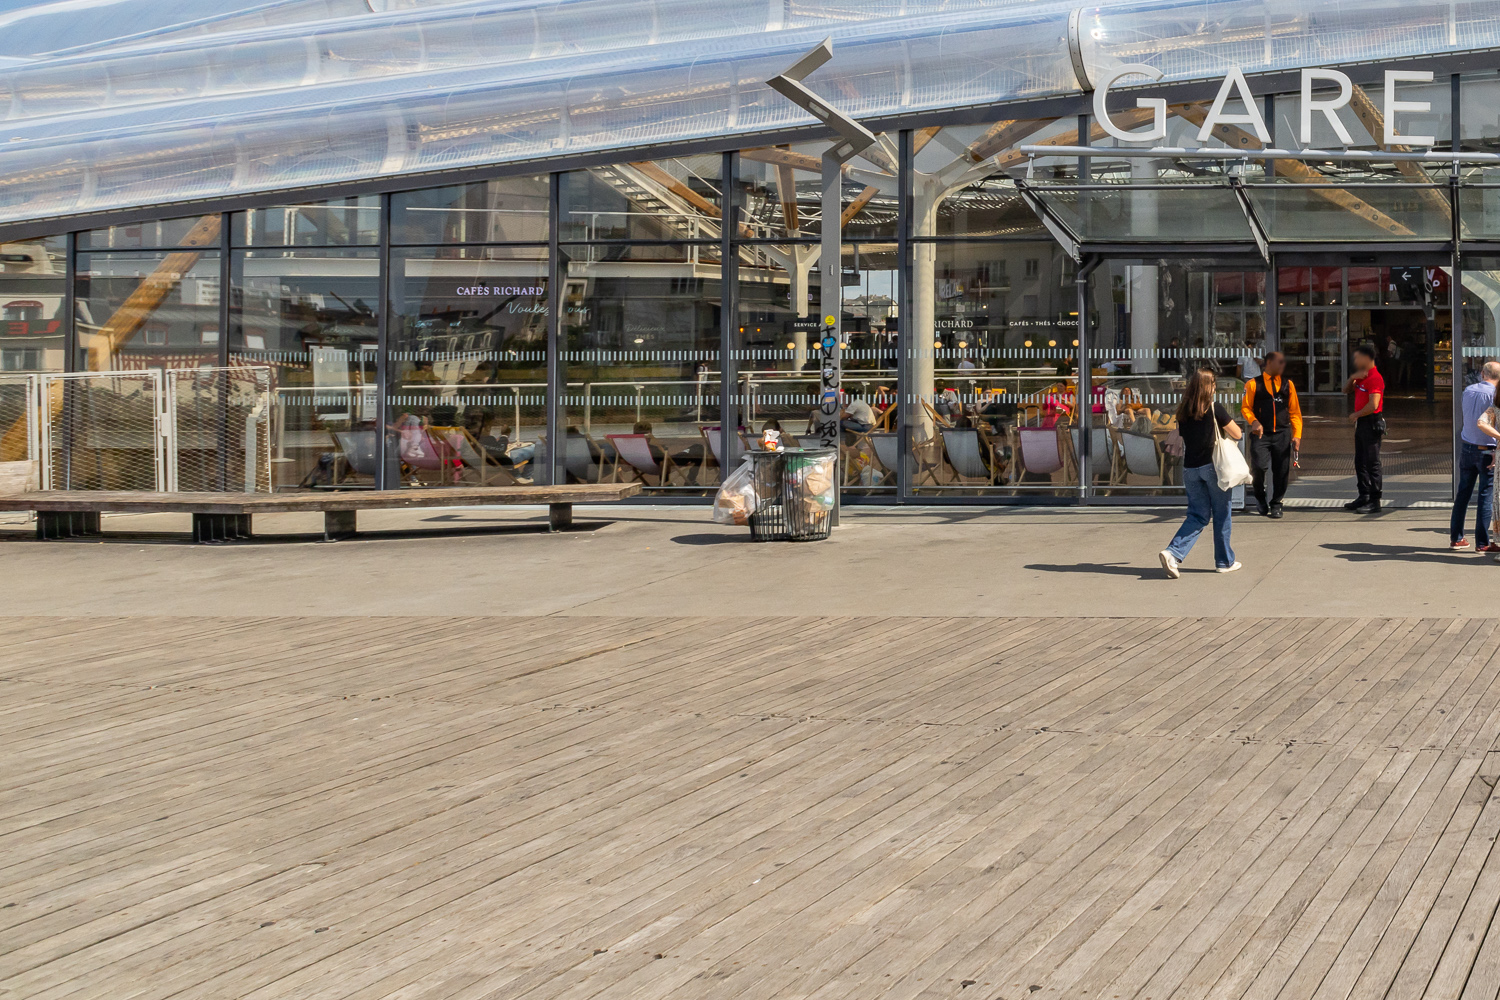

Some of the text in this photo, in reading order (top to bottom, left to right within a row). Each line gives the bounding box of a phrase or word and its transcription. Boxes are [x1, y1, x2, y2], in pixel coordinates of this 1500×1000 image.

[1092, 63, 1435, 146] GARE
[457, 285, 544, 296] CAFÉS RICHARD
